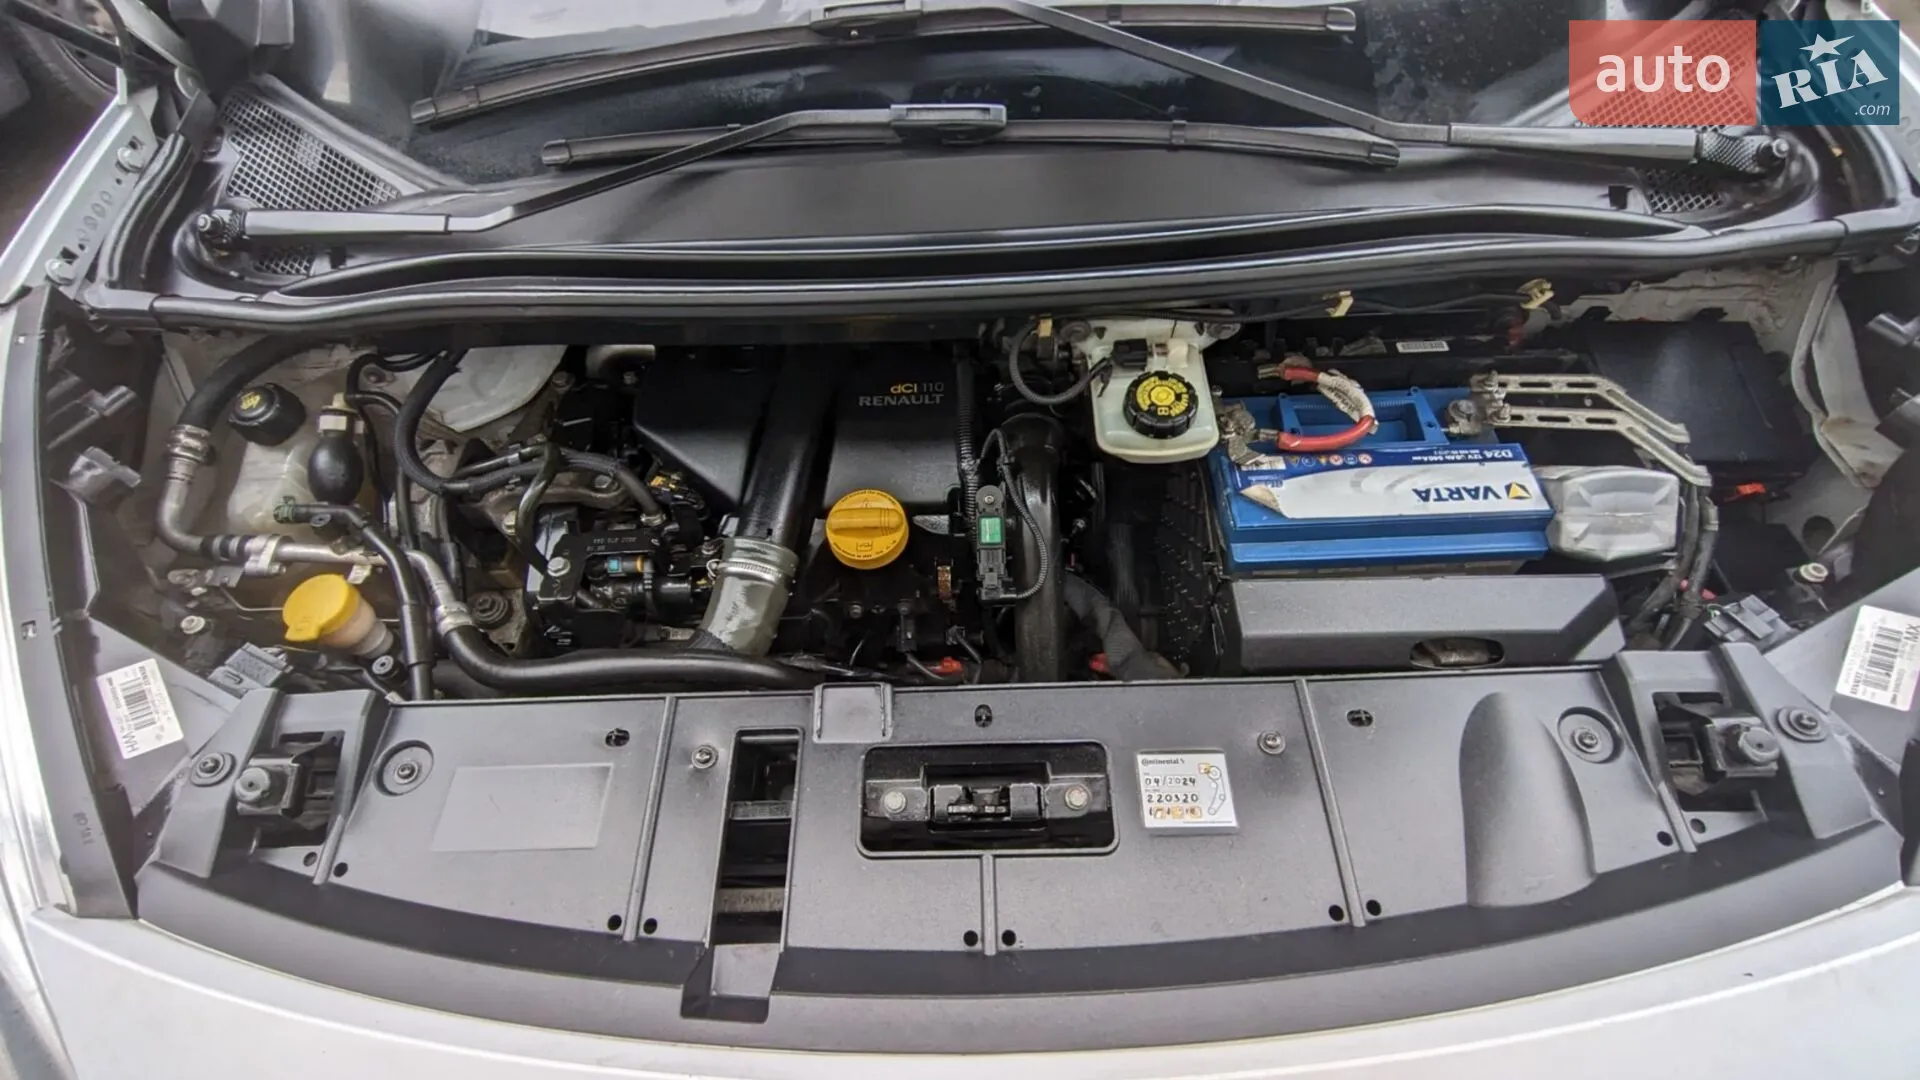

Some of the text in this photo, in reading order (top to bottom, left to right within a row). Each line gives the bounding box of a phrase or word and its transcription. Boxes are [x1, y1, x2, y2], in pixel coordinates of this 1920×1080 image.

[923, 382, 945, 393] 110
[858, 394, 945, 407] RENAULT
[1484, 448, 1513, 459] D24
[1412, 485, 1502, 503] VARTA
[122, 731, 139, 754] WH
